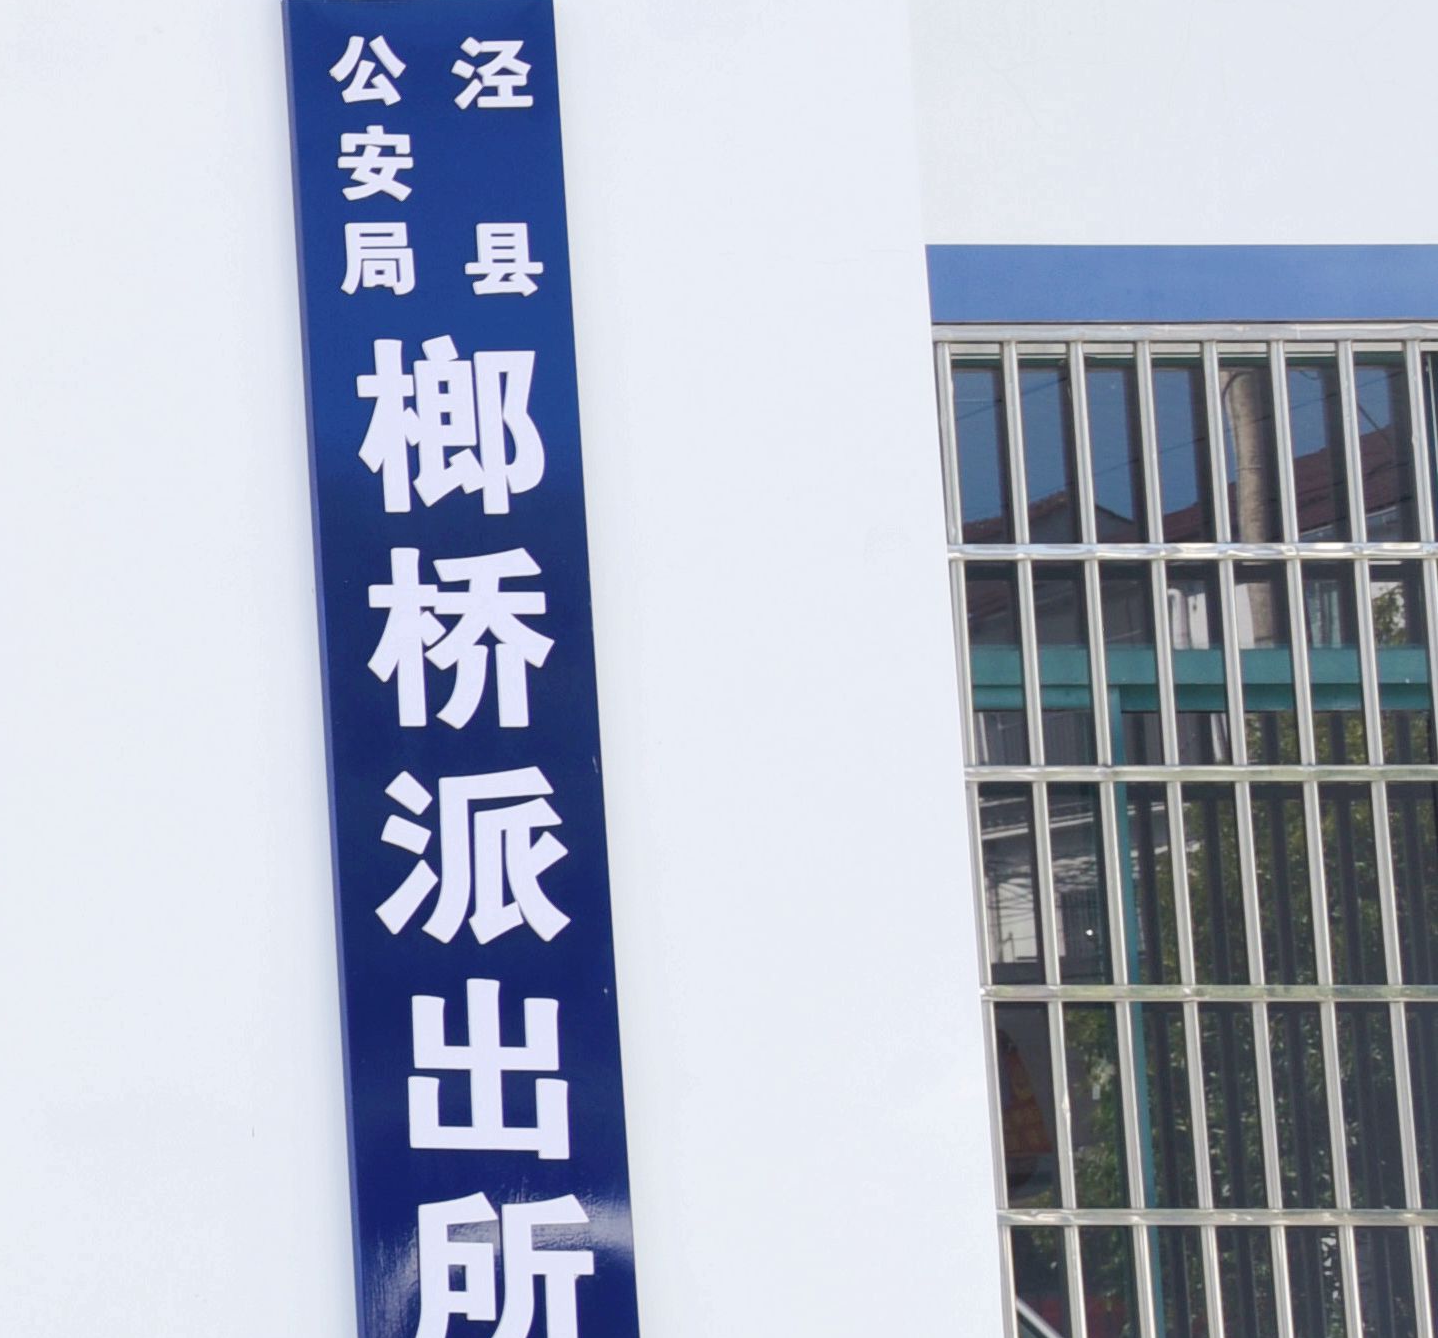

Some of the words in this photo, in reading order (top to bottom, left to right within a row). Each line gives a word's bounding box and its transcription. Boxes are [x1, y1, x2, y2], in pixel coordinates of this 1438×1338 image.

[329, 35, 416, 297] 公安局
[451, 36, 544, 298] 泾县
